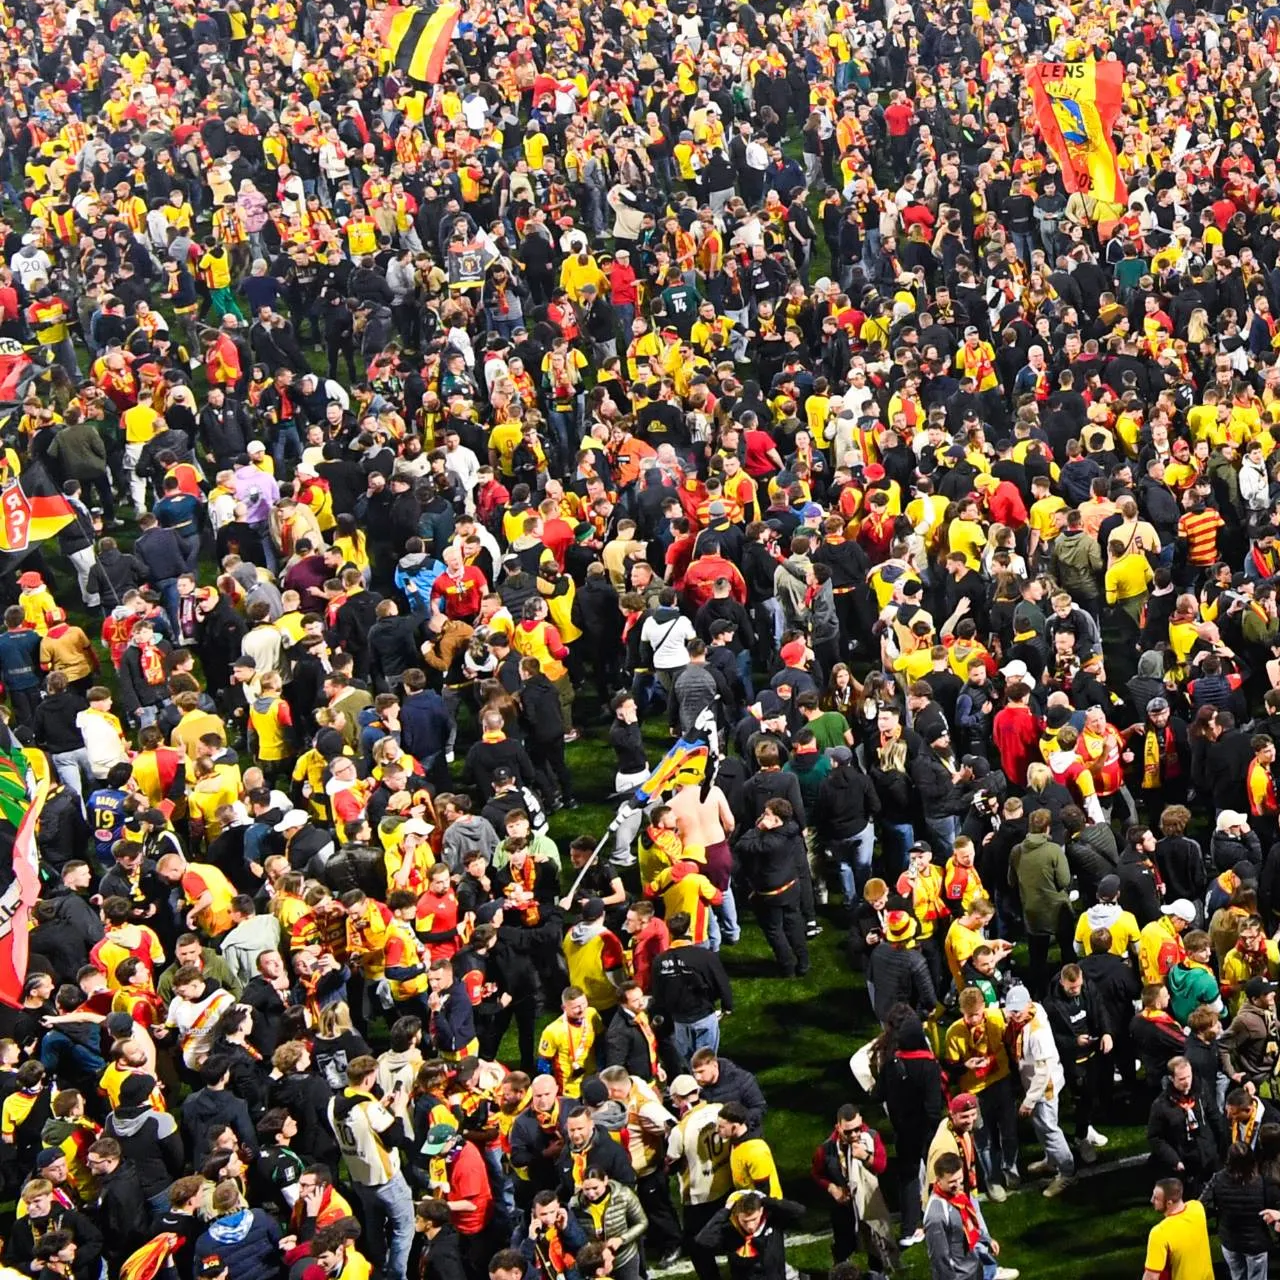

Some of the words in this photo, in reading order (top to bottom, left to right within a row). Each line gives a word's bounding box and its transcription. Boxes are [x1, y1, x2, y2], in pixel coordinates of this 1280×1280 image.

[1041, 64, 1085, 79] LENS
[23, 261, 41, 273] 20
[673, 299, 687, 313] 14
[94, 808, 115, 829] 19
[337, 1122, 356, 1146] 10
[704, 1131, 725, 1157] 10
